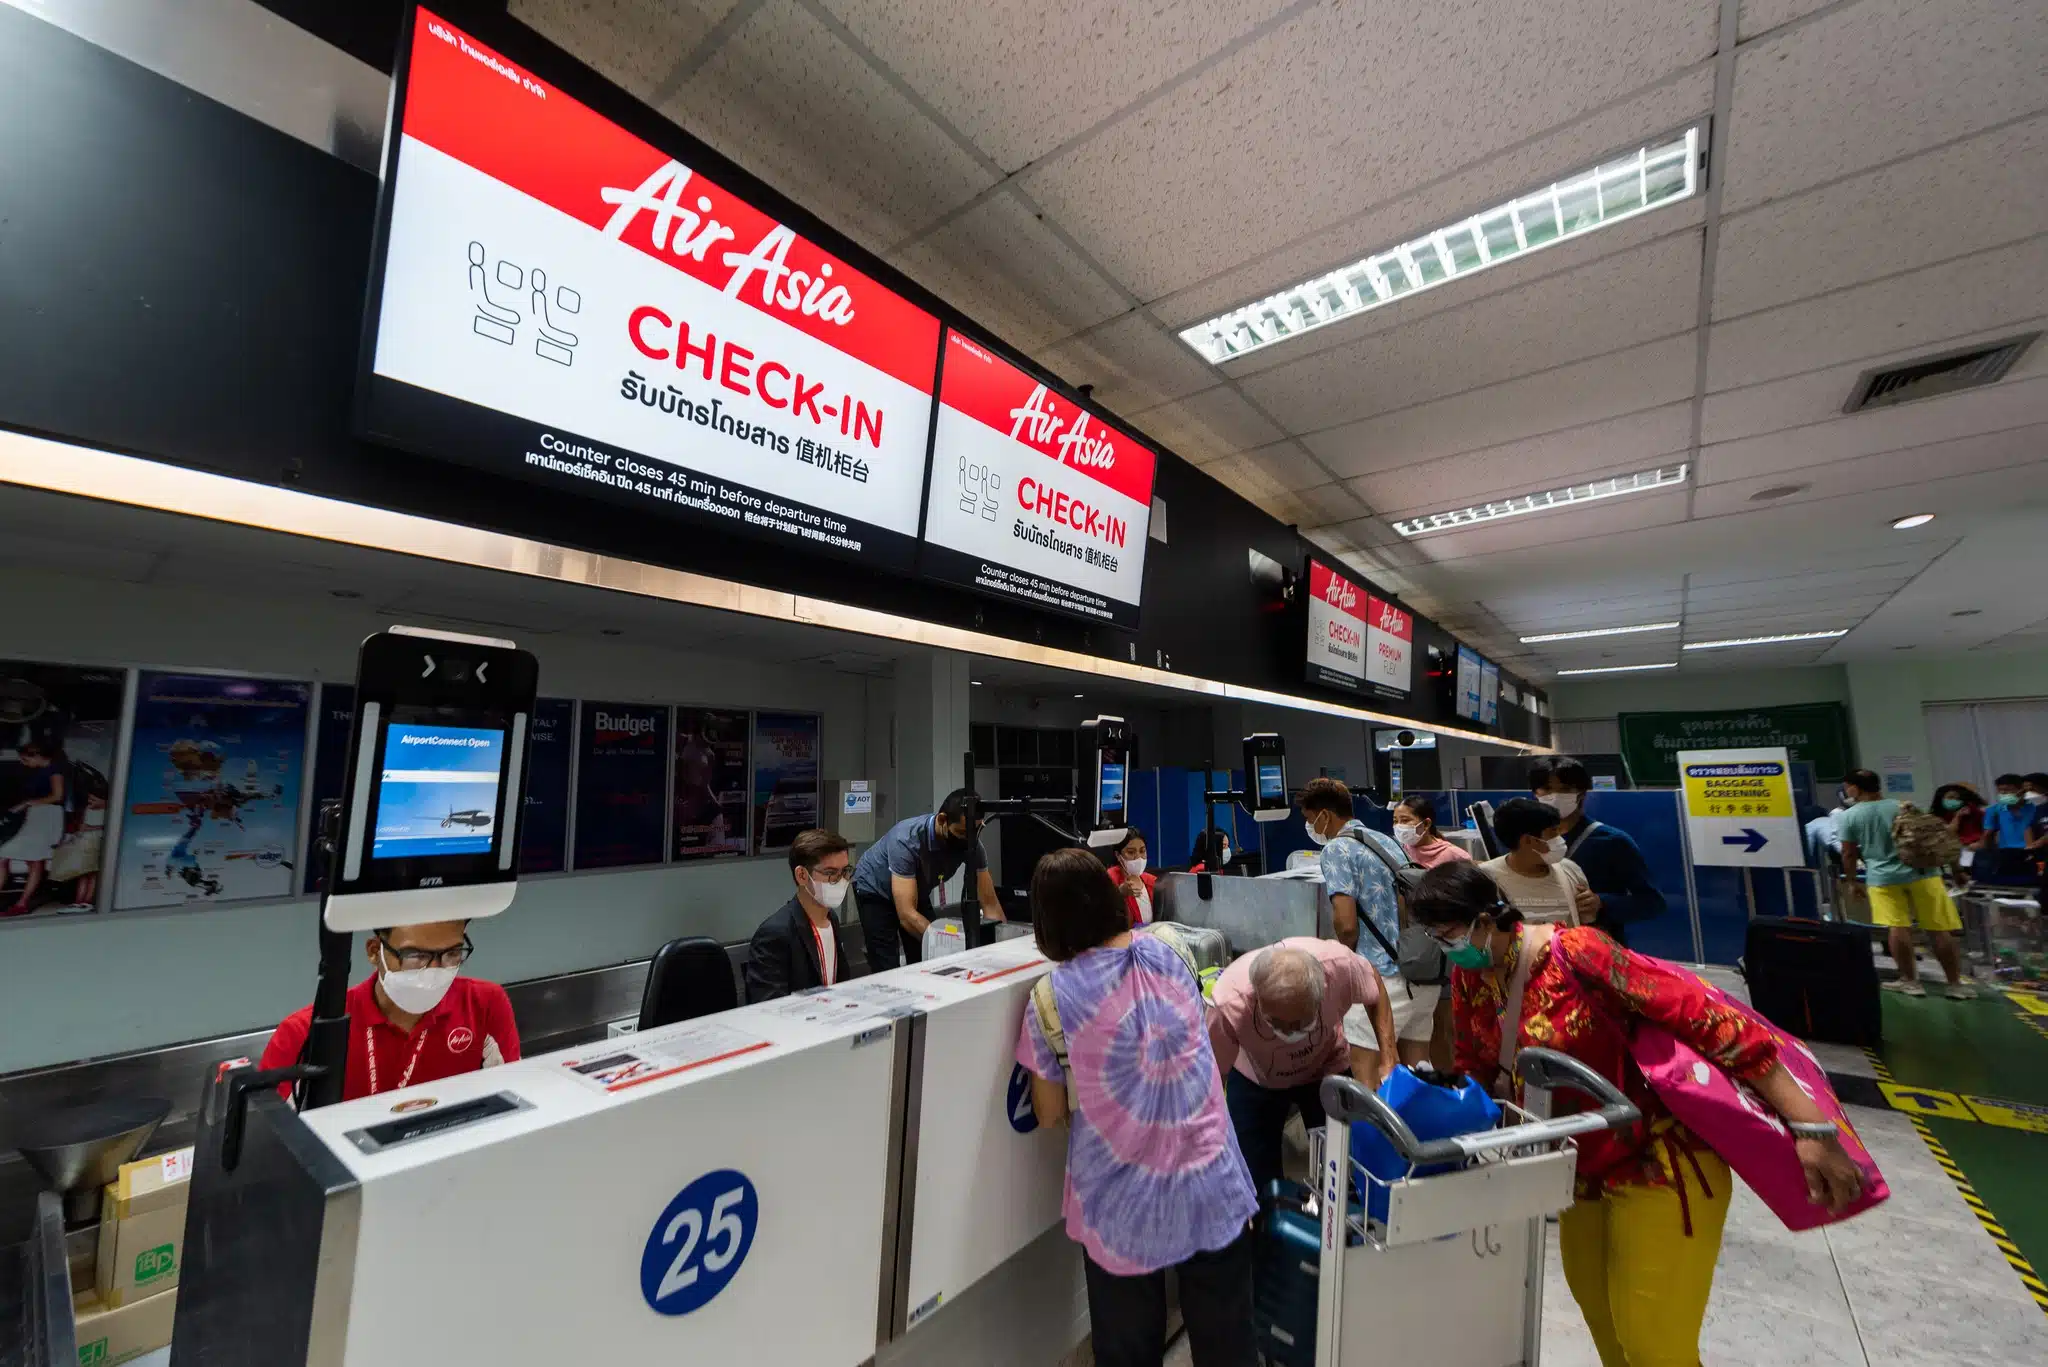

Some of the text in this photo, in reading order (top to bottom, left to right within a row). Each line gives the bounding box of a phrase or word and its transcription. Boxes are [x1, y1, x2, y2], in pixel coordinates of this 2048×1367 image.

[628, 305, 883, 448] CHECK-IN
[620, 370, 870, 483] รับบัตรโดยสาร 值机柜台
[540, 433, 847, 533] Counter closes 45 min before departure time
[616, 474, 633, 490] ปิด
[634, 481, 651, 495] 45
[652, 487, 673, 501] นาที
[1017, 476, 1126, 548] CHECK-IN
[1013, 518, 1118, 573] รับบัตรโดยสาร 值机柜台
[981, 563, 1107, 608] Counter closes 45 min before departure time
[1329, 620, 1360, 648] CHECK-IN
[1378, 642, 1402, 662] PREMIUM
[595, 711, 656, 737] Budget
[400, 734, 490, 748] AirportConnect Open
[1703, 788, 1771, 798] SCREENING
[1706, 779, 1764, 788] BAGGAGE
[419, 877, 443, 886] SITA
[656, 1185, 744, 1302] 25
